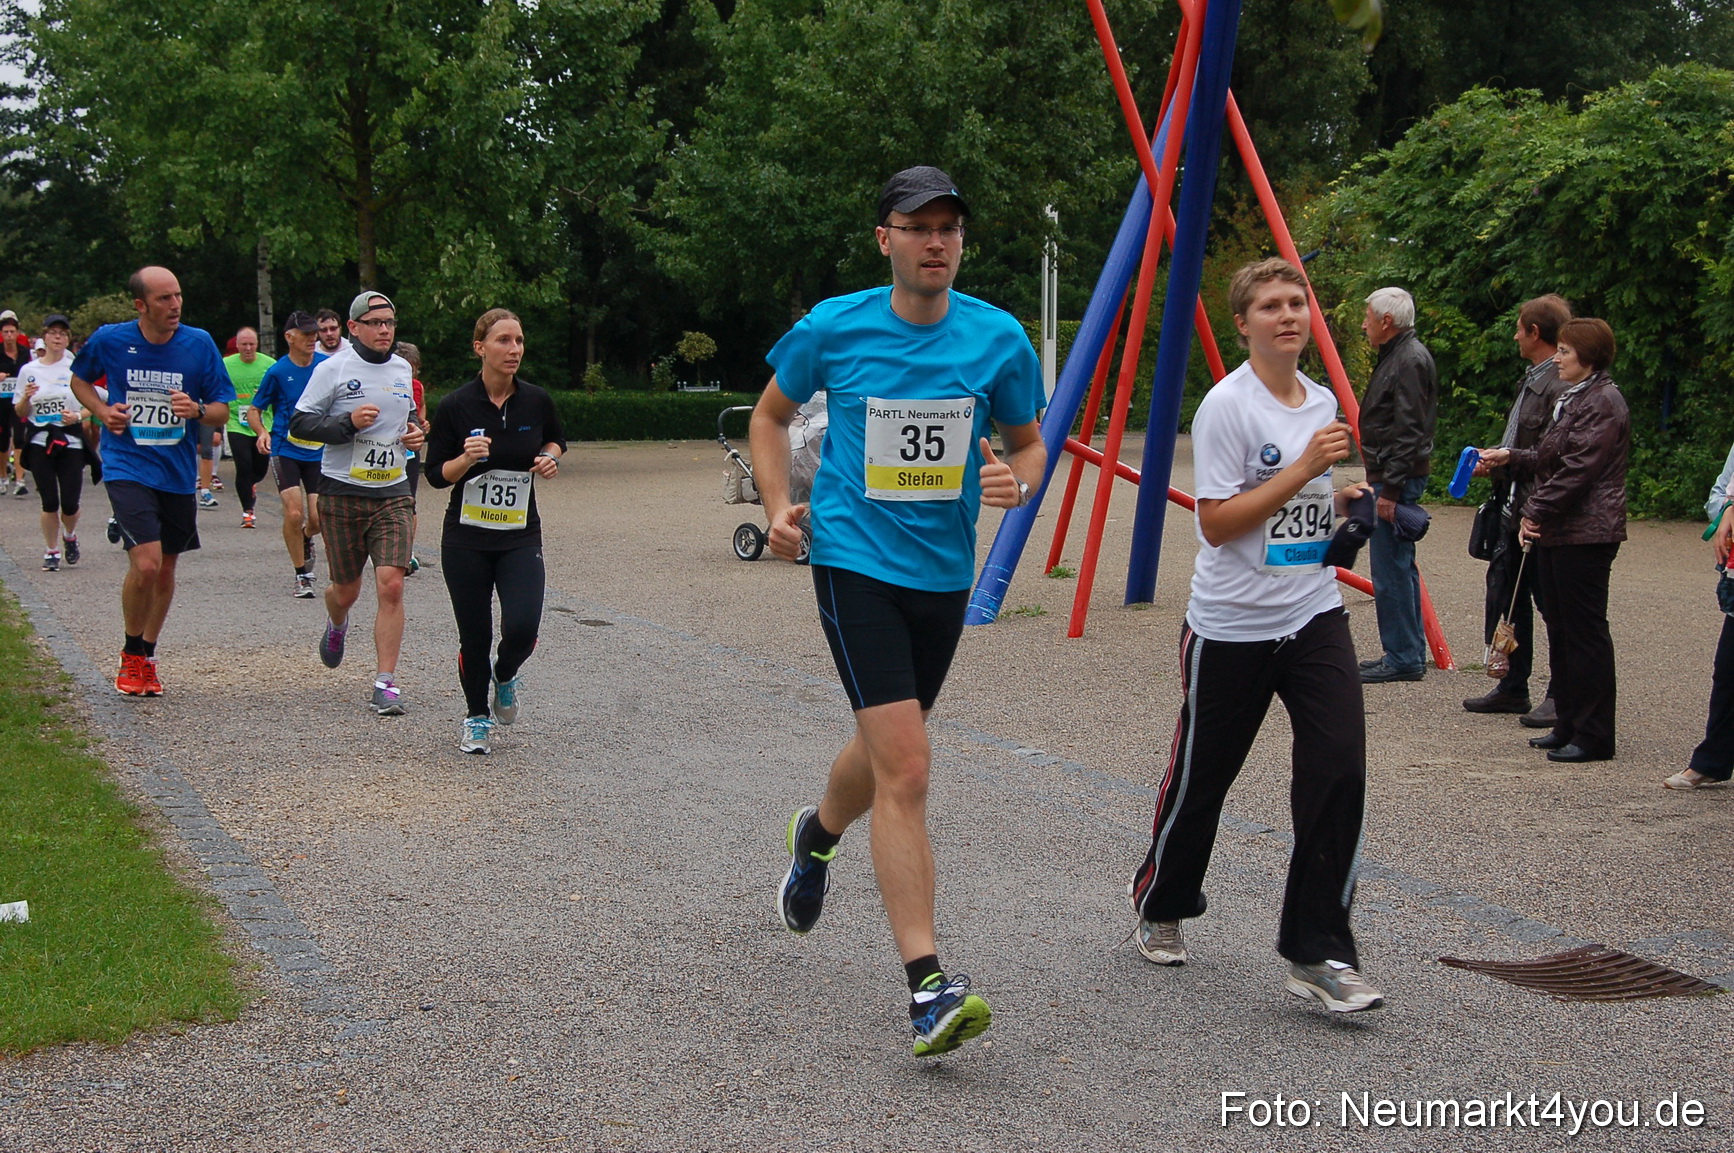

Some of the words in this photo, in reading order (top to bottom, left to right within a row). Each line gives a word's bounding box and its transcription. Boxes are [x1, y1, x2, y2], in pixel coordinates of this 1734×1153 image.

[127, 369, 183, 384] HUBER
[36, 401, 65, 415] 2535
[132, 404, 181, 425] 2768
[868, 407, 905, 419] PARTL
[907, 409, 960, 420] Neumarkt
[138, 429, 173, 438] Willibald
[900, 424, 945, 462] 35
[364, 448, 395, 468] 441
[366, 470, 391, 480] Robert
[897, 471, 943, 486] Stefan
[479, 482, 517, 507] 135
[480, 510, 507, 521] Nicole
[1270, 503, 1332, 539] 2394
[1284, 547, 1318, 562] Claudia
